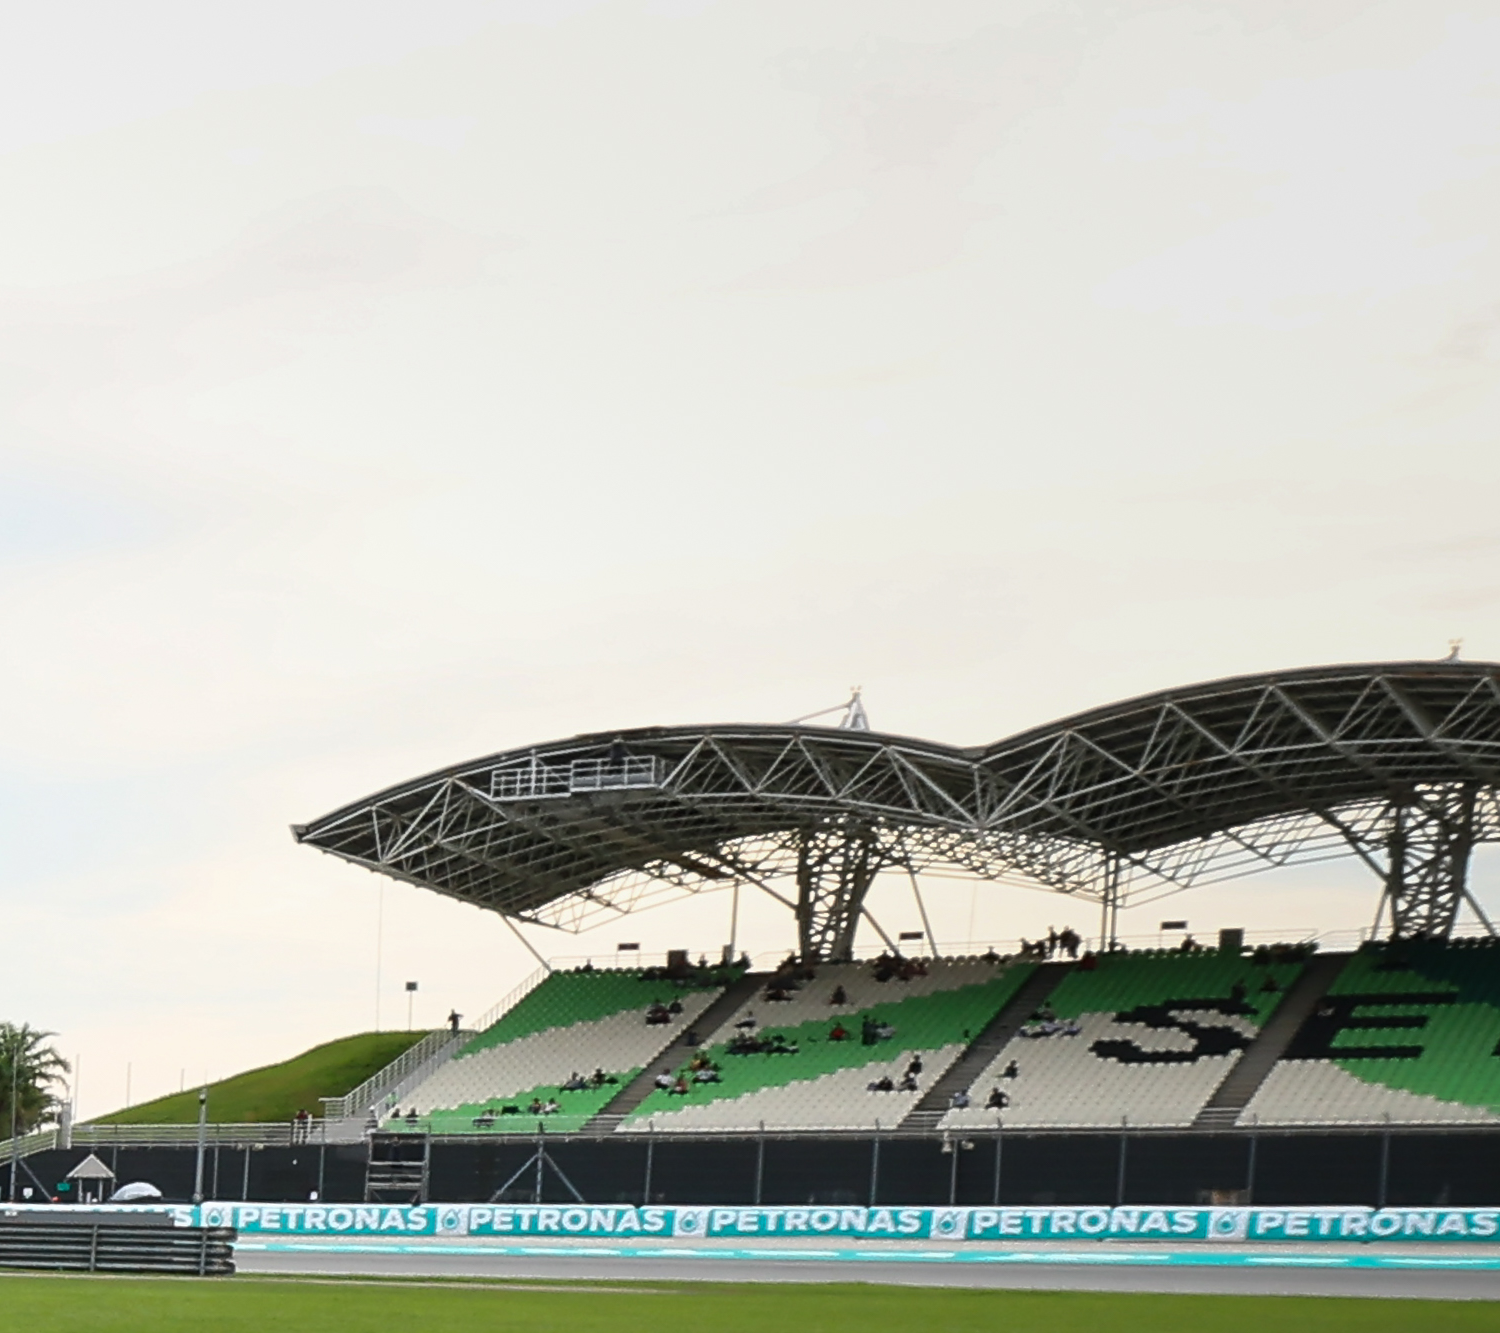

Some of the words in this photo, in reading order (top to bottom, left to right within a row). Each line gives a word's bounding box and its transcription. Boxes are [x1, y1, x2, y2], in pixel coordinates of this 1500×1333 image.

[1089, 993, 1460, 1063] SE
[238, 1207, 428, 1232] PETRONAS
[471, 1209, 665, 1233] PETRONAS
[712, 1209, 922, 1234] PETRONAS
[974, 1210, 1197, 1235] PETRONAS
[1255, 1211, 1500, 1237] PETRONAS
